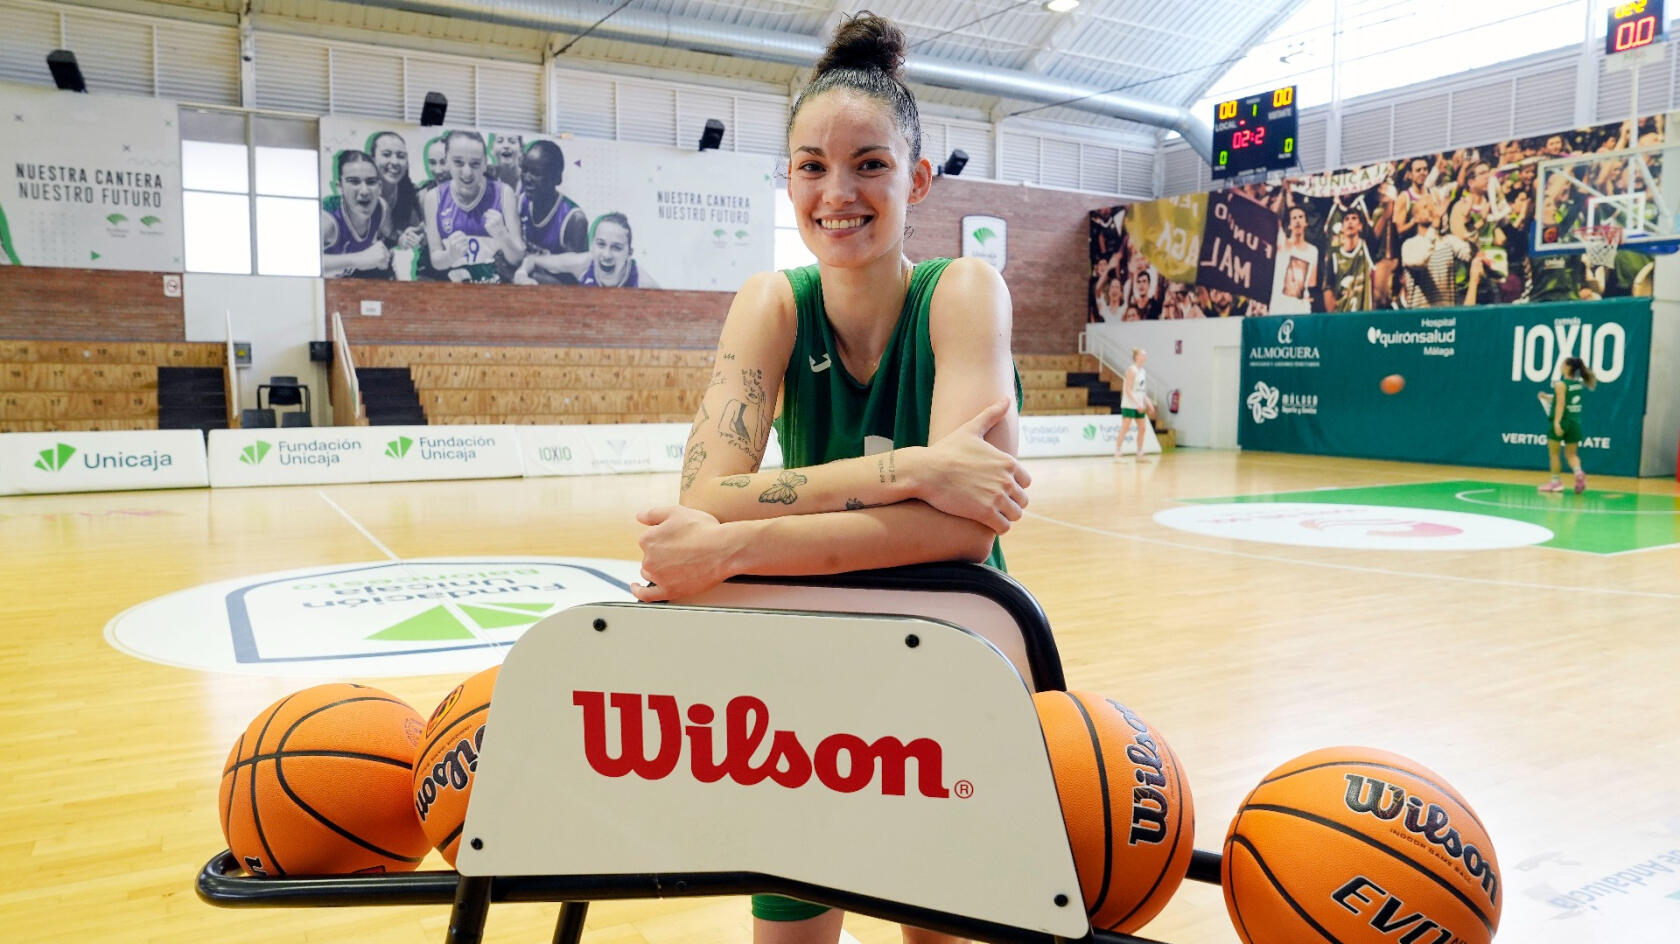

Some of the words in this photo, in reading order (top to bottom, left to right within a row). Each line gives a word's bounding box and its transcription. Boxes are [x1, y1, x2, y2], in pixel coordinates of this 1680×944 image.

[1273, 86, 1293, 108] 00
[1219, 100, 1238, 120] 00
[1284, 137, 1294, 154] 0
[1219, 150, 1229, 165] 0
[16, 163, 87, 183] NUESTRA
[96, 170, 163, 188] CANTERA
[19, 182, 94, 204] NUESTRO
[102, 188, 162, 208] FUTURO
[657, 191, 702, 205] NUESTRA
[706, 194, 750, 209] CANTERA
[658, 206, 705, 221] NUESTRO
[710, 208, 750, 224] FUTURO
[1421, 317, 1457, 328] Hospital
[1249, 347, 1320, 359] ALMOGUERA
[278, 438, 362, 453] Fundación
[419, 435, 496, 449] Fundación
[84, 451, 173, 471] Unicaja
[279, 451, 340, 467] Unicaja
[420, 448, 477, 463] Unicaja
[302, 582, 567, 608] Fundación
[333, 577, 516, 597] Unicaja
[572, 690, 950, 799] Wilson
[1344, 772, 1501, 908] Wilson
[1389, 828, 1427, 849] INDOOR
